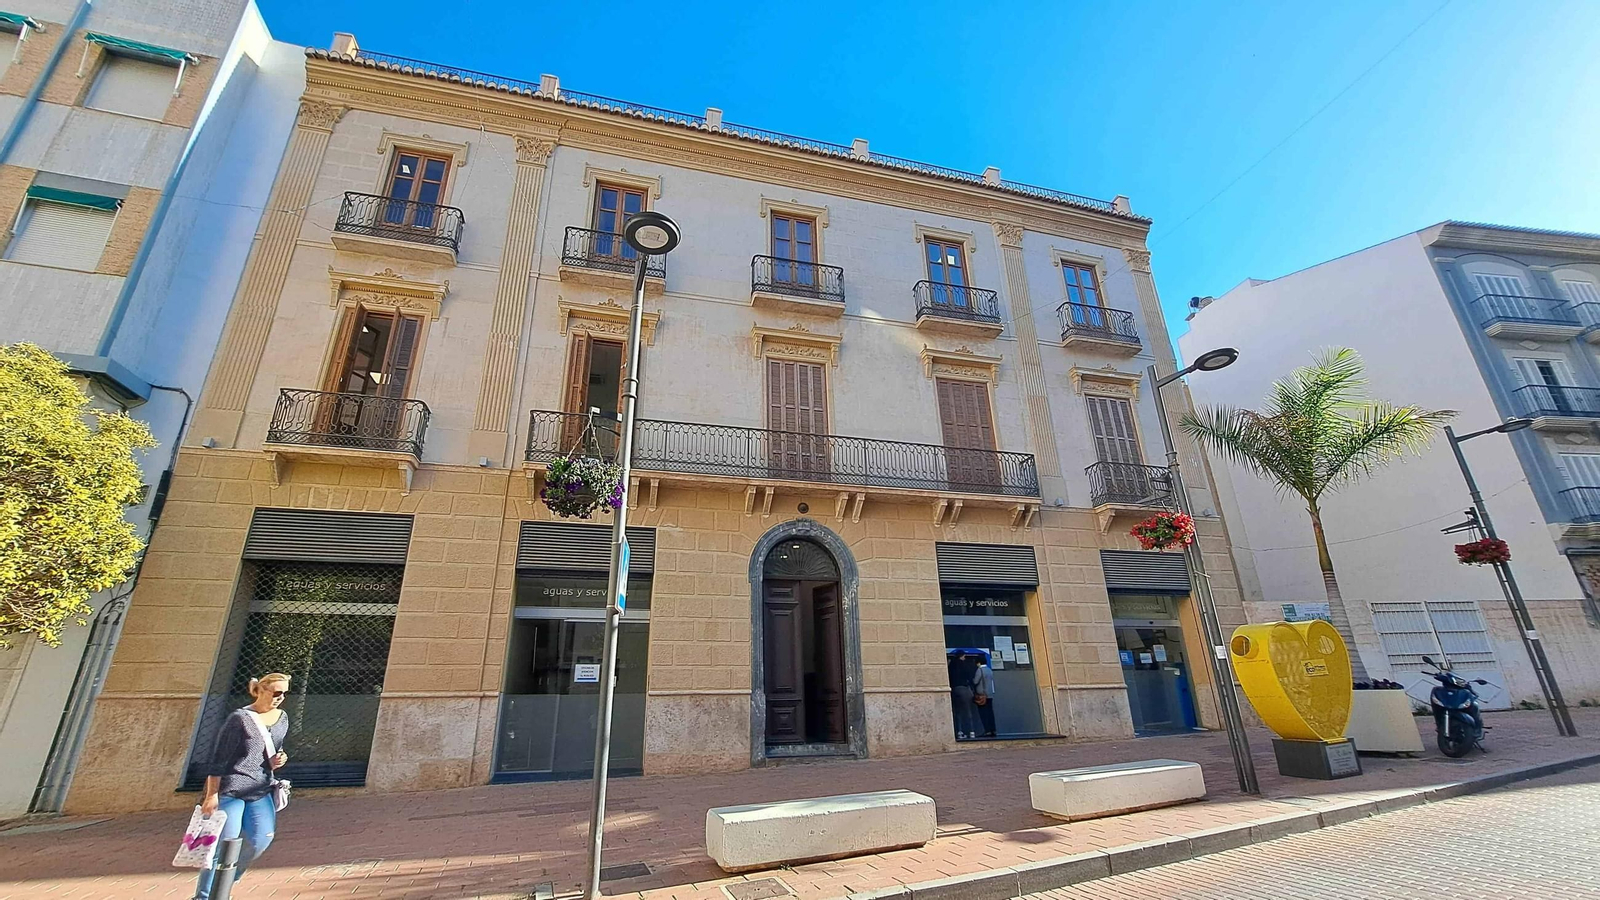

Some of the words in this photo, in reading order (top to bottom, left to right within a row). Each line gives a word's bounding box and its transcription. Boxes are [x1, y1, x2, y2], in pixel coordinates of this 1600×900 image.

[335, 581, 387, 591] servicios
[543, 587, 574, 597] aguas
[576, 589, 583, 598] y
[945, 599, 967, 607] aguas
